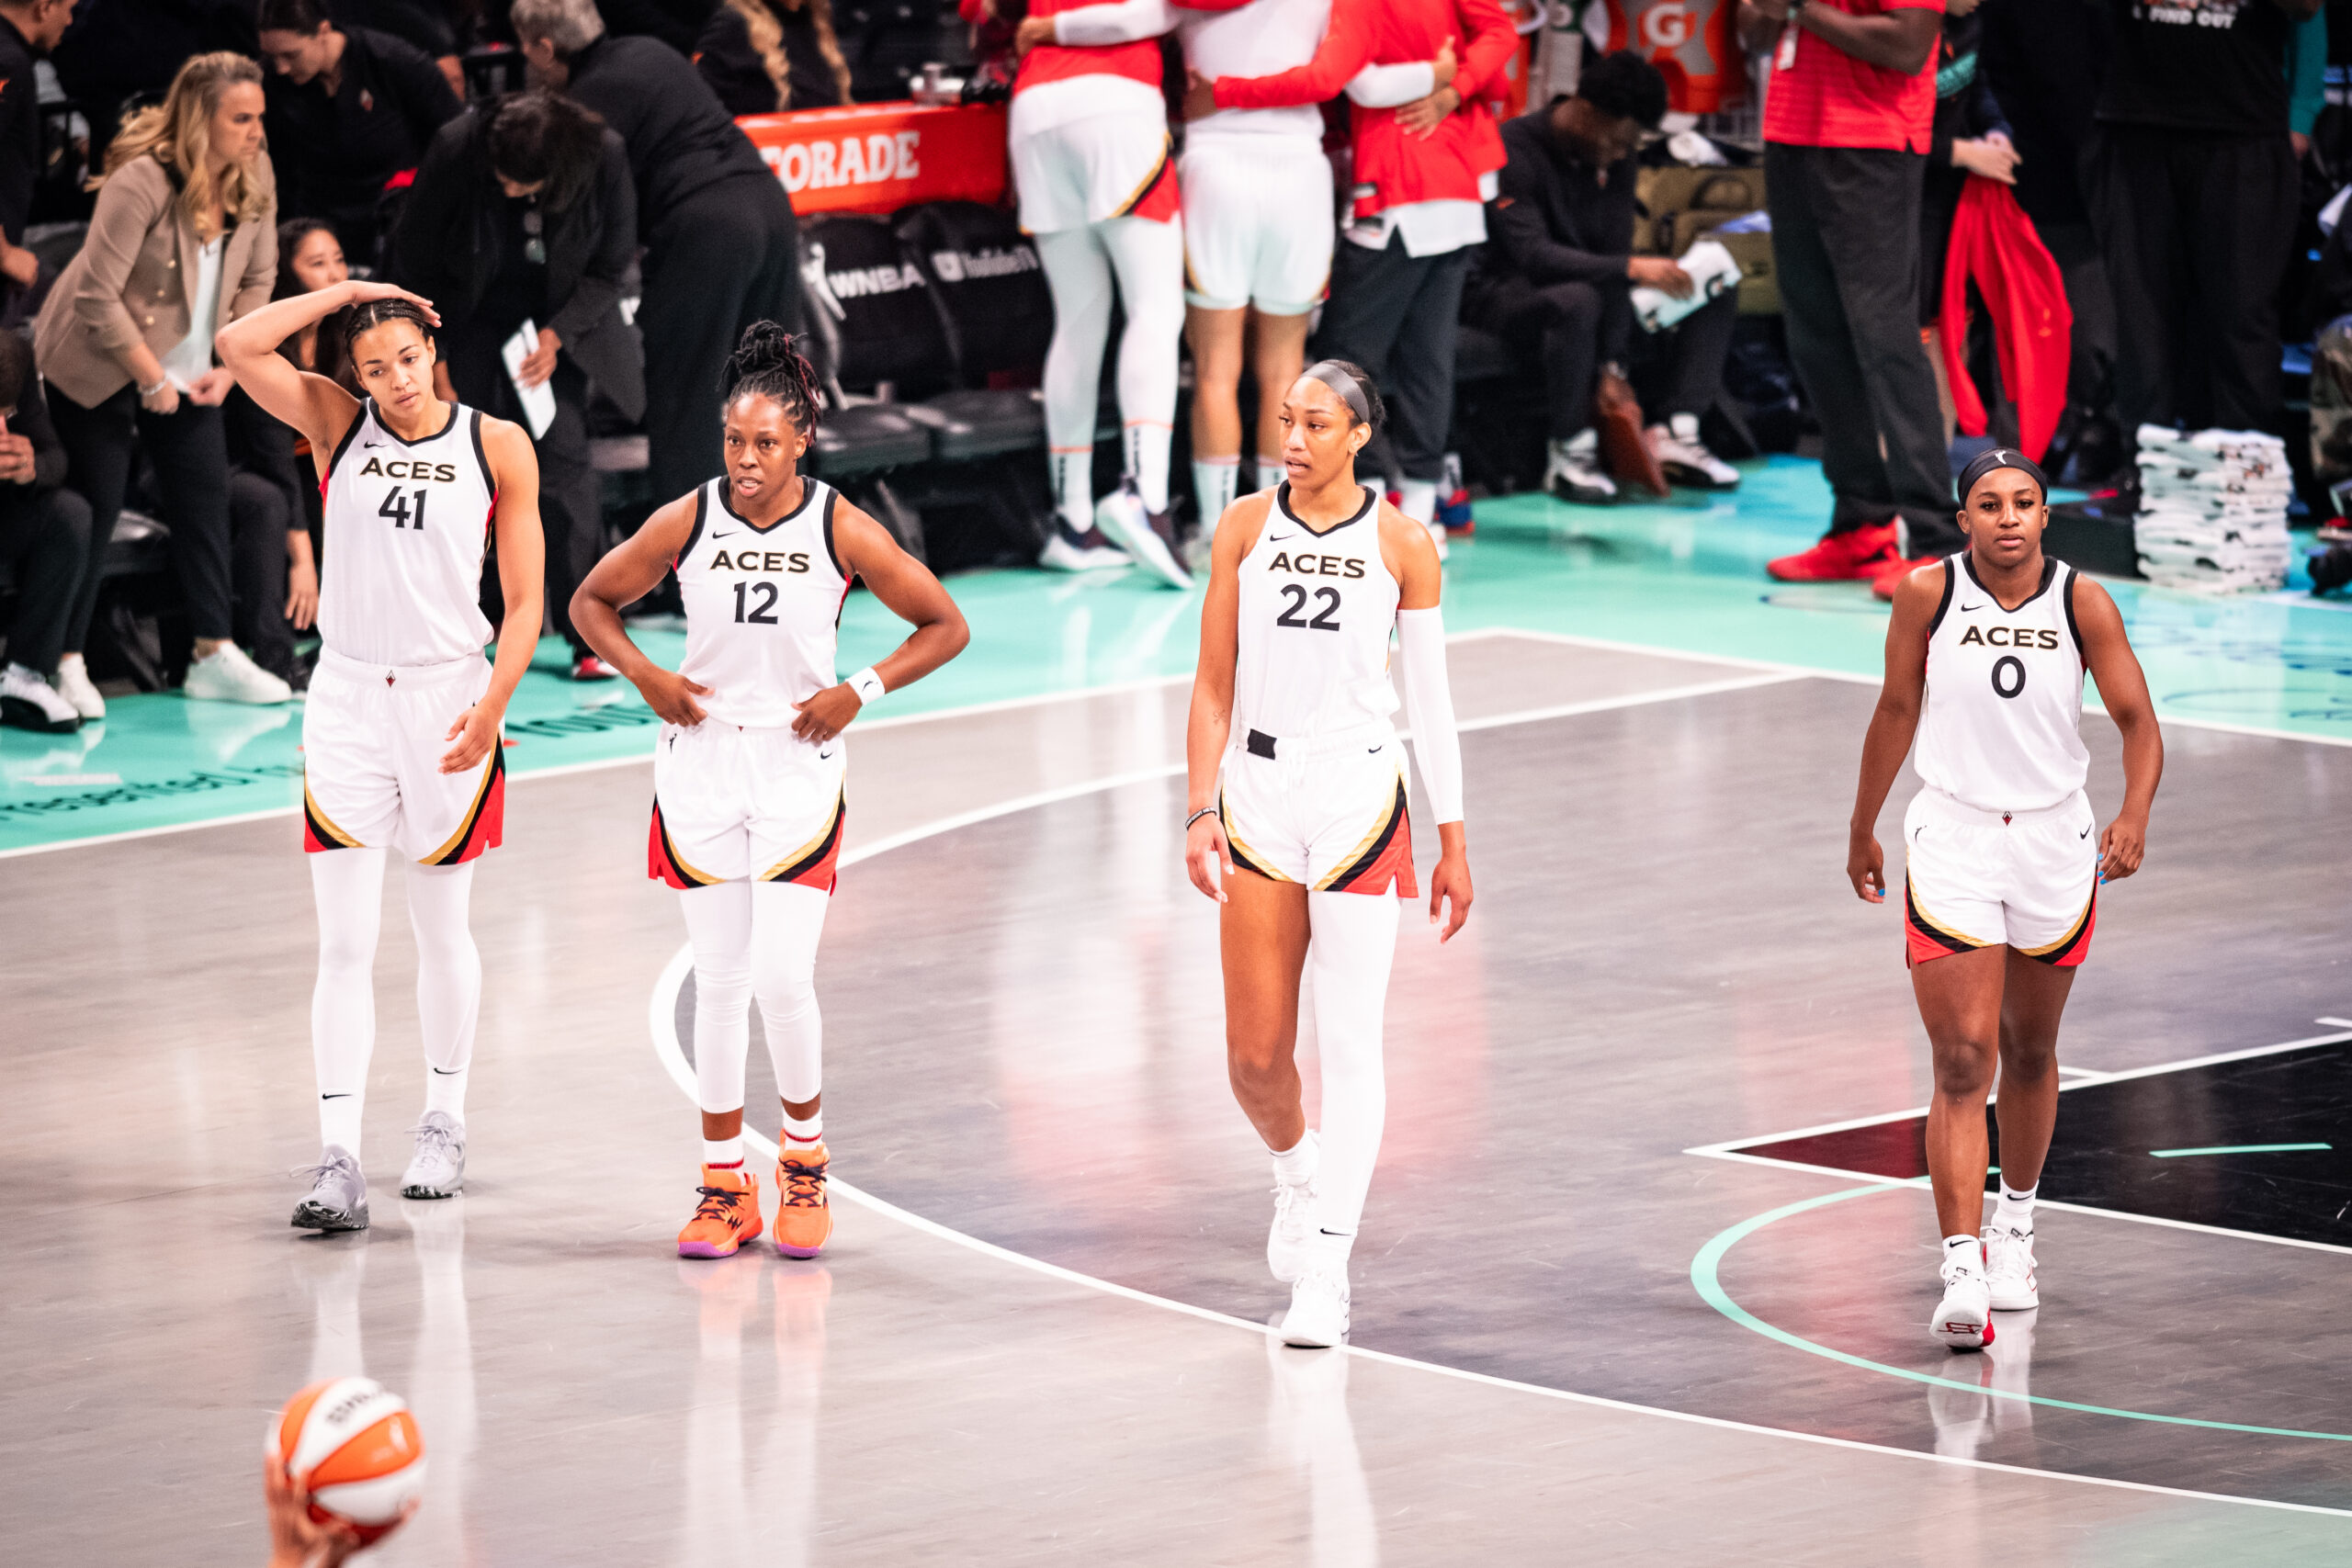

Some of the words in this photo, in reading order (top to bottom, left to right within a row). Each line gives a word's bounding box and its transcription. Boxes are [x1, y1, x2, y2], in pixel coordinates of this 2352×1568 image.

[828, 264, 926, 299] WNBA
[359, 457, 457, 483] ACES
[379, 485, 427, 531] 41
[709, 549, 811, 574] ACES
[1268, 551, 1366, 580] ACES
[733, 581, 779, 626] 12
[1276, 583, 1341, 632] 22
[1959, 625, 2060, 650] ACES
[1991, 655, 2027, 699] 0
